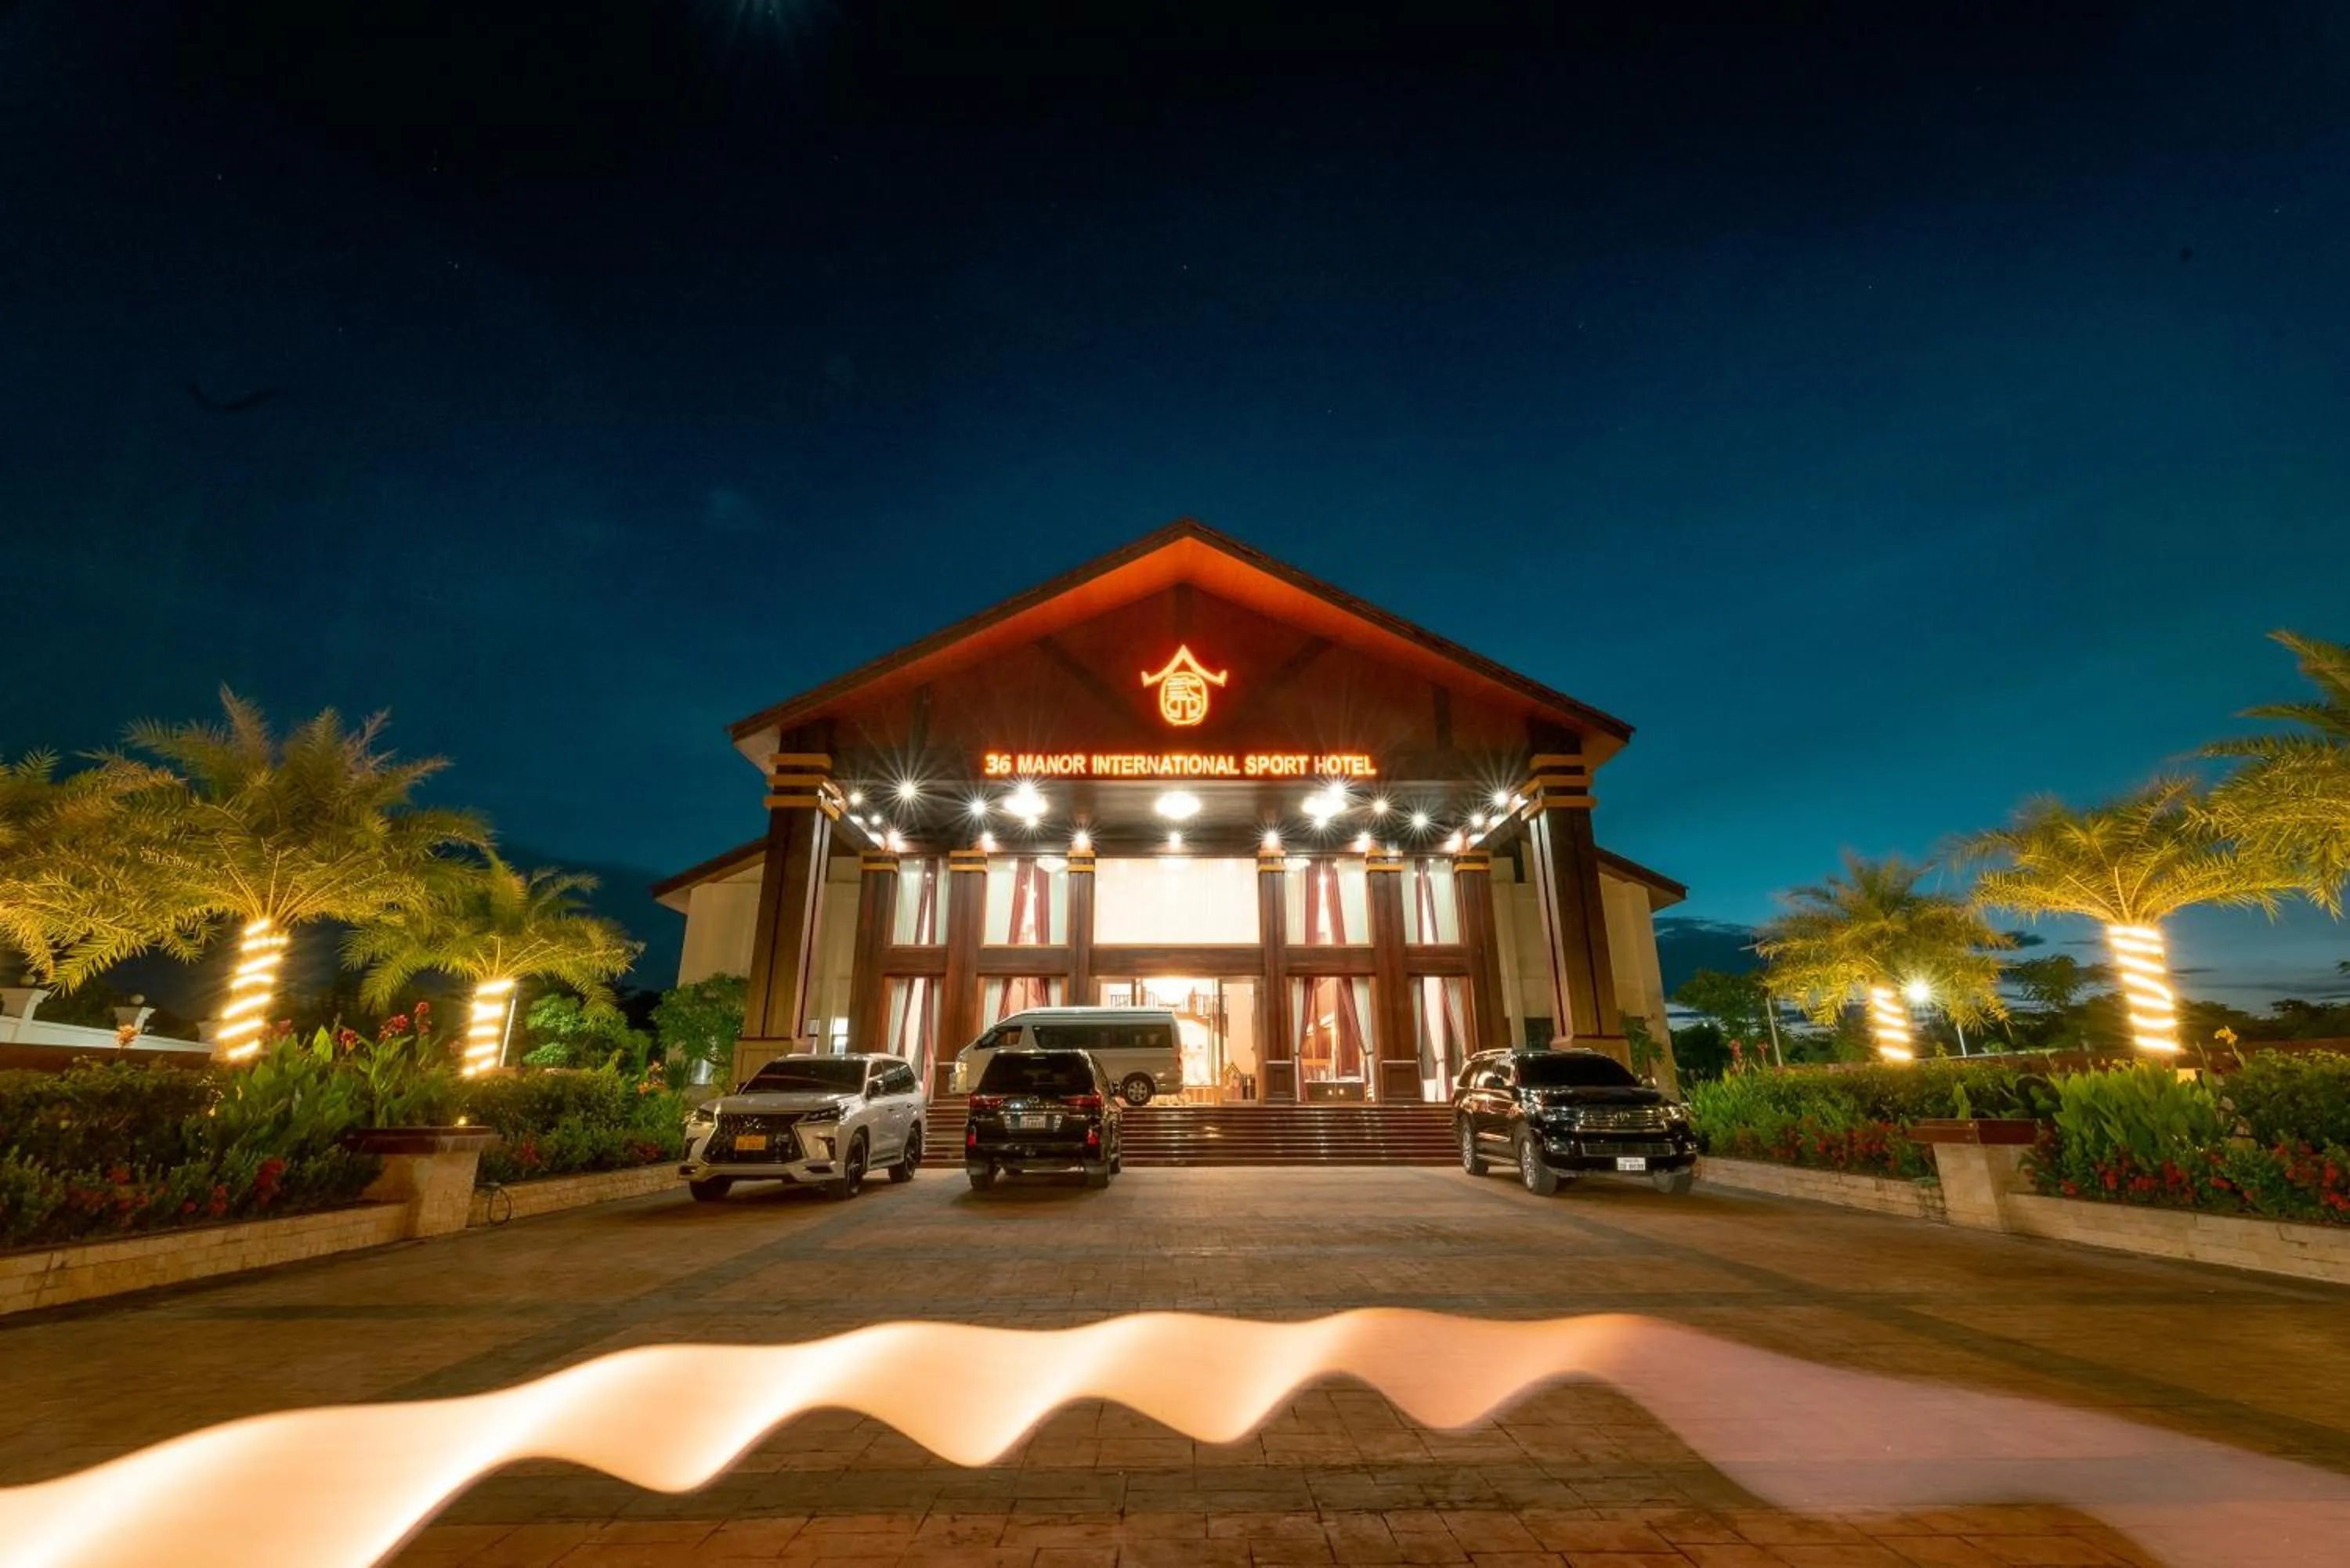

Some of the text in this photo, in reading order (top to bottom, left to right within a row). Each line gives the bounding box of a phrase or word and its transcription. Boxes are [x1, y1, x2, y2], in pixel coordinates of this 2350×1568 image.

[985, 753, 1377, 775] 36 MANOR INTERNATIONAL SPORT HOTEL
